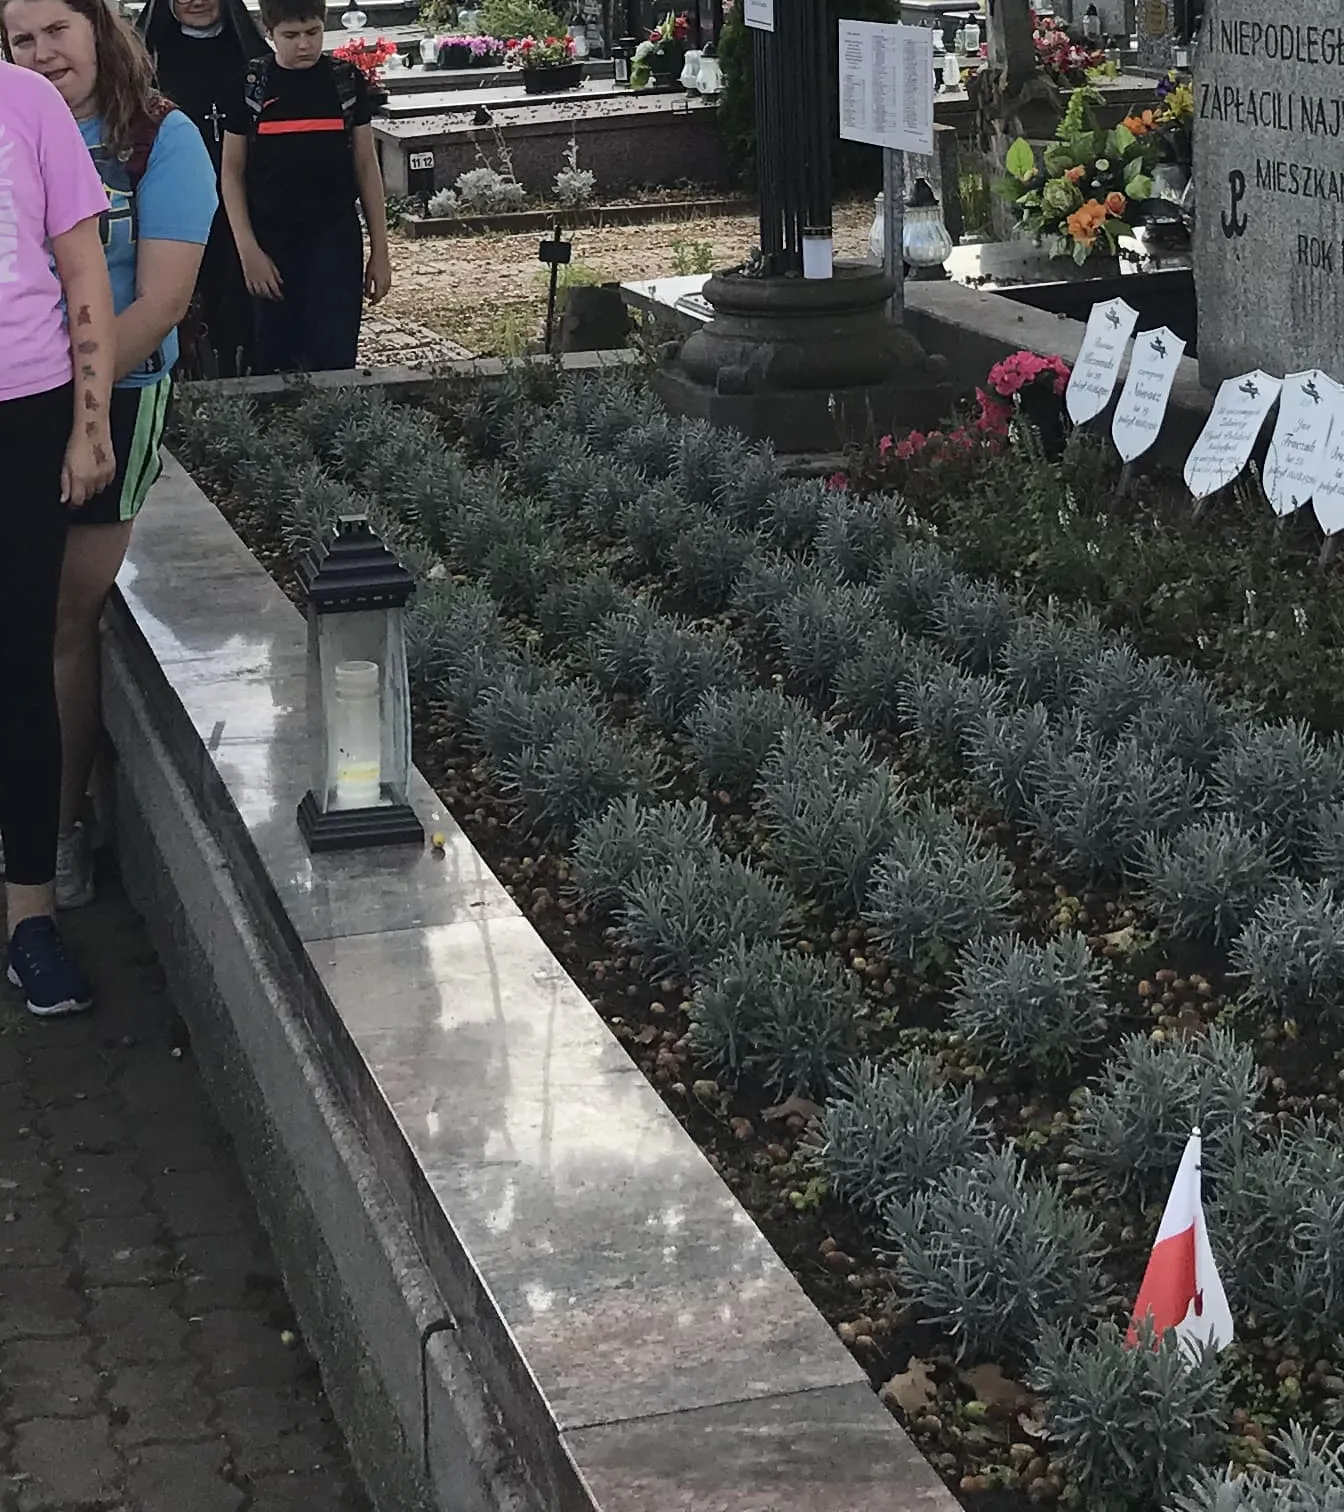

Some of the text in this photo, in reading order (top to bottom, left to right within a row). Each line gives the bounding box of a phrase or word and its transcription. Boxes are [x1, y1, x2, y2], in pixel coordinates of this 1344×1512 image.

[1200, 83, 1293, 132] ZAPŁACILI
[423, 156, 433, 167] 12
[1298, 234, 1335, 274] ROK
